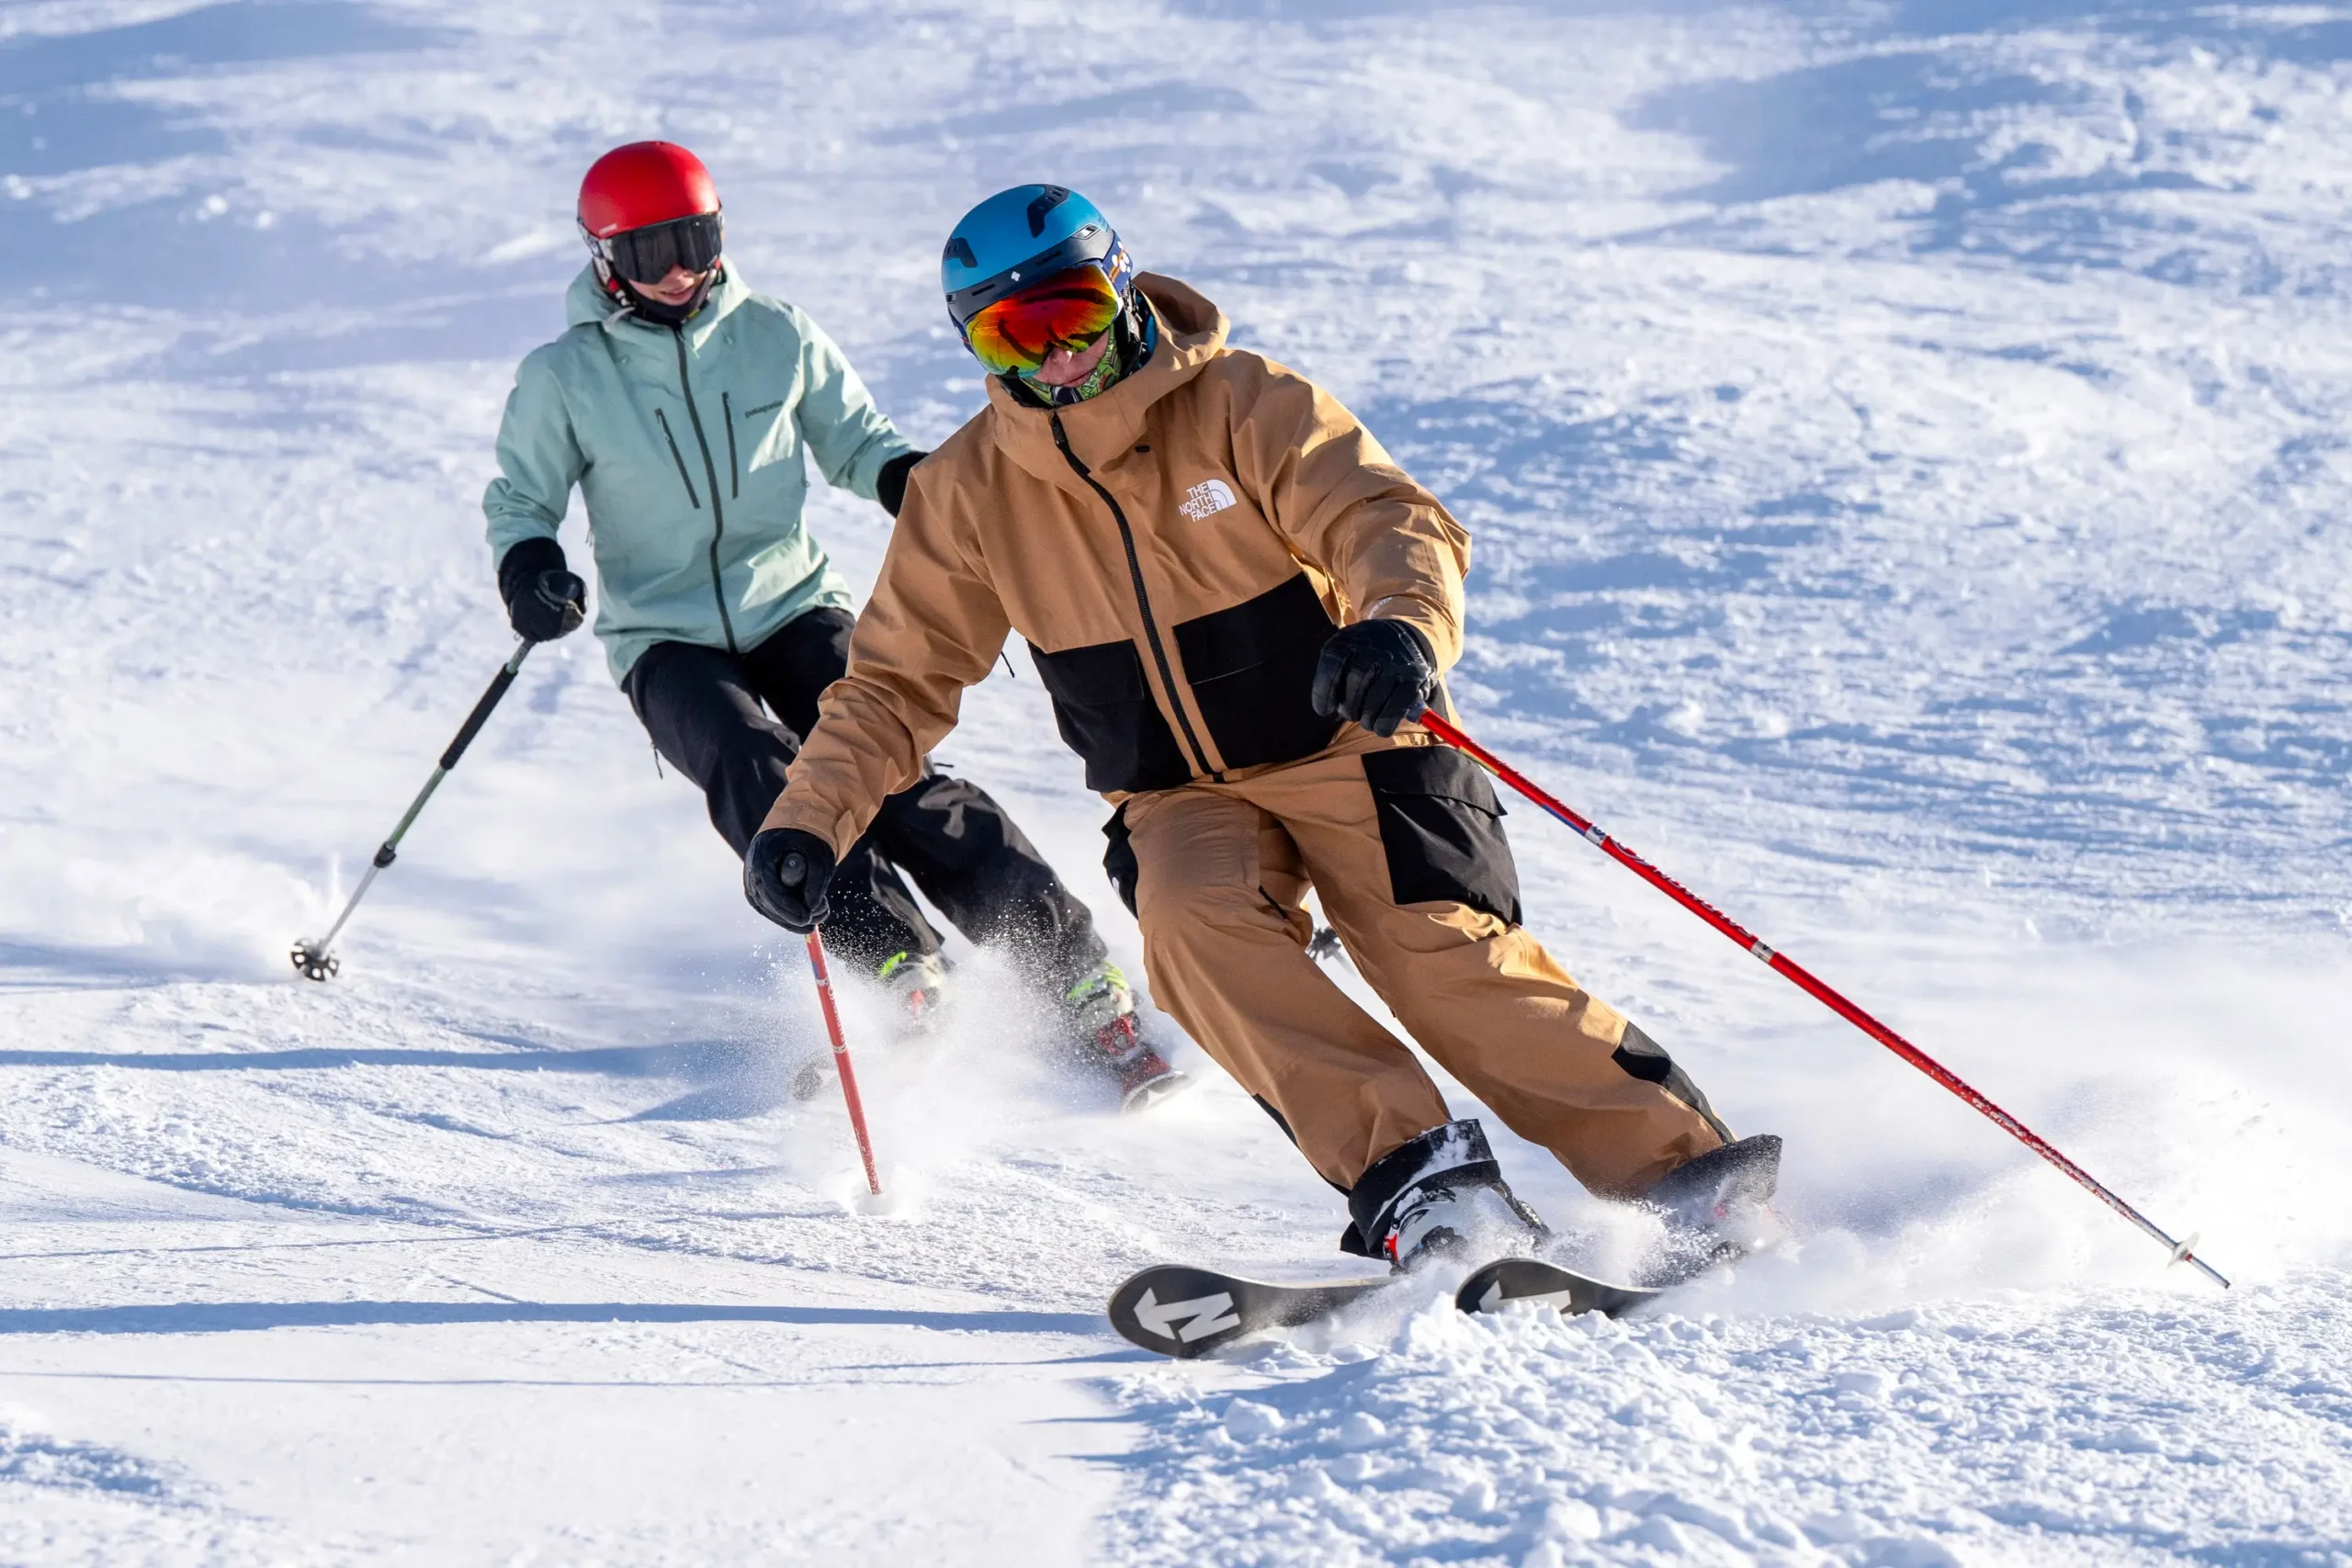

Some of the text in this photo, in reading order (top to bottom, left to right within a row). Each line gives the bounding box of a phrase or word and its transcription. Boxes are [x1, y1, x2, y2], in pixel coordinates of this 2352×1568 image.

[1186, 481, 1210, 498] THE
[1178, 491, 1214, 516] NORTH
[1190, 502, 1217, 523] FACE
